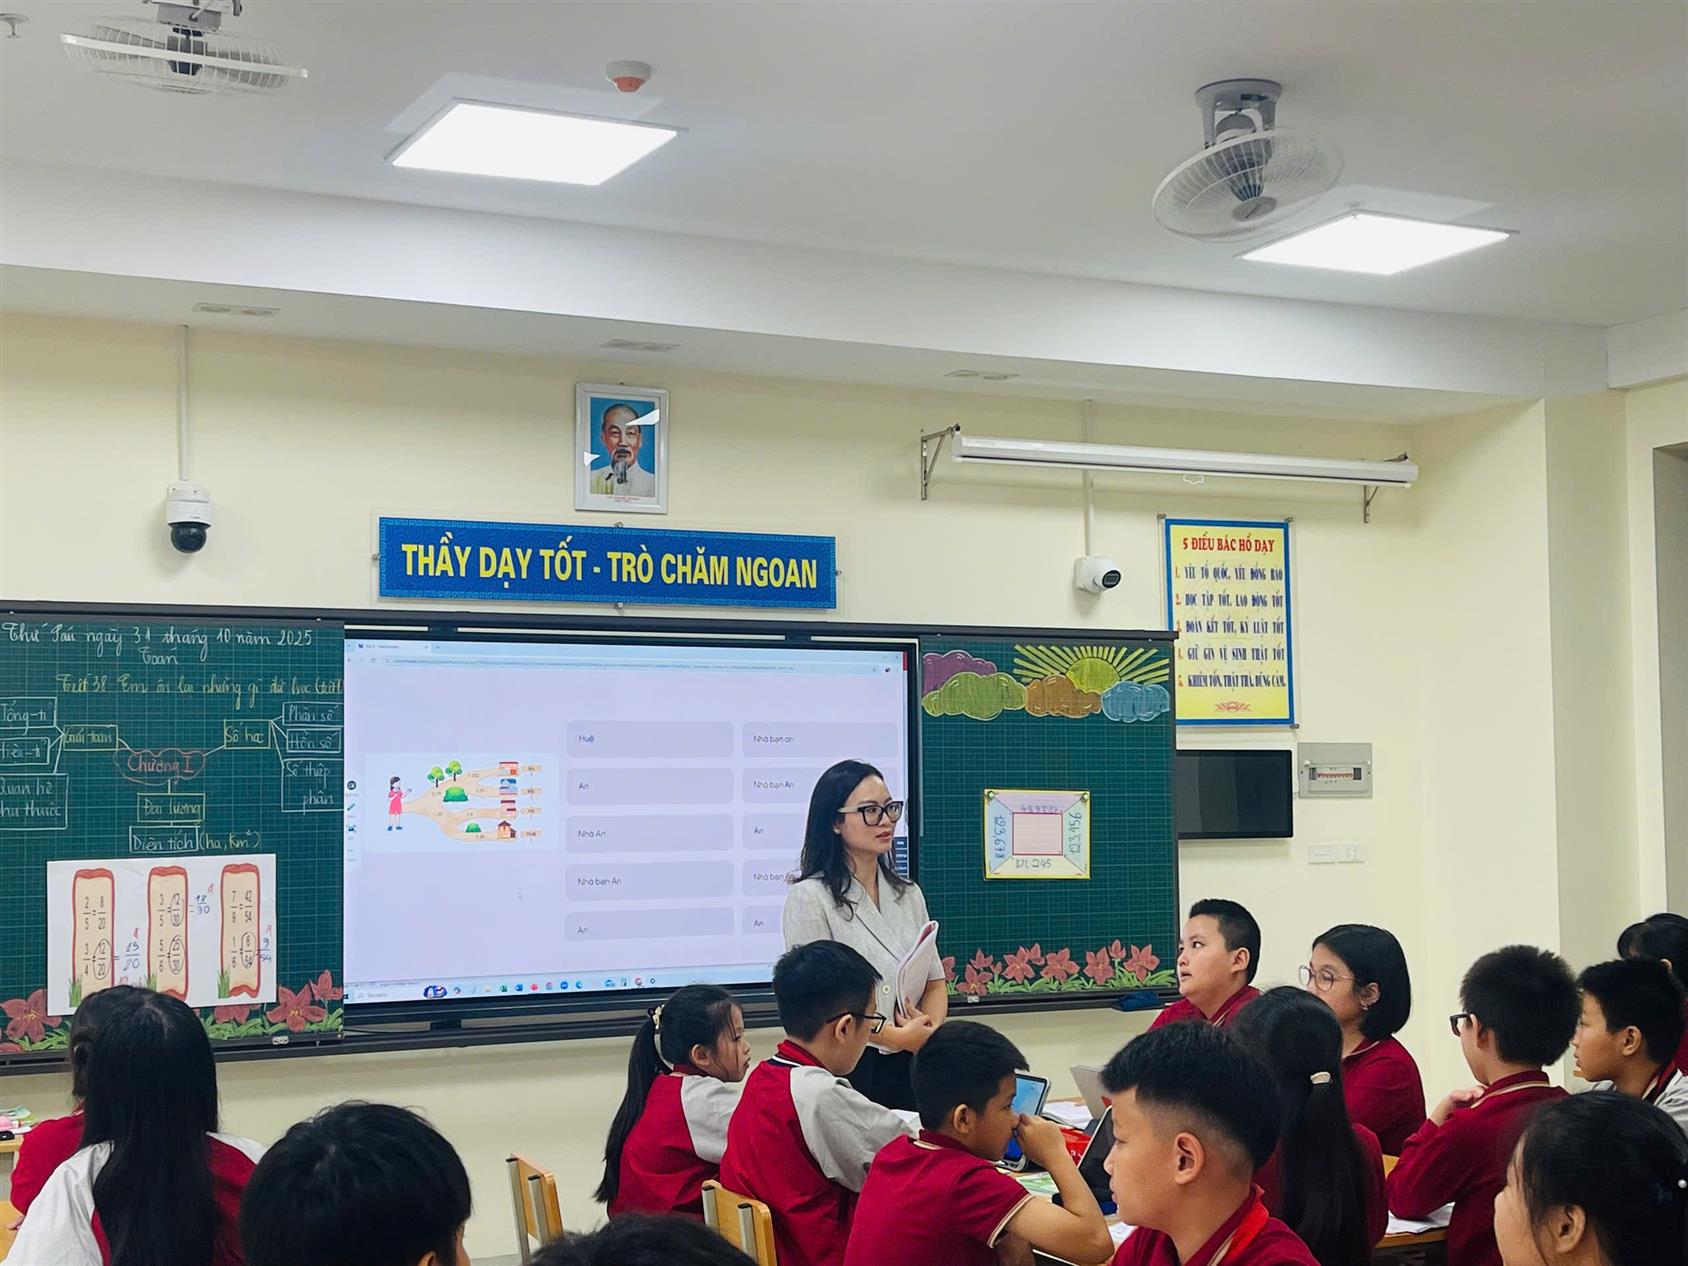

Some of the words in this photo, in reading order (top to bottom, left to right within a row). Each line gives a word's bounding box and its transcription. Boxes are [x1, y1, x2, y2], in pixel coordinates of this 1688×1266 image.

[1183, 538, 1188, 549] 5
[1217, 534, 1236, 551] BÁC
[1255, 540, 1275, 555] DẠY
[402, 531, 471, 577] THẦY
[479, 547, 532, 588] DẠY
[539, 535, 586, 580] TỐT
[607, 544, 654, 583] TRÒ
[660, 546, 729, 585] CHĂM
[736, 556, 817, 588] NGOAN
[86, 628, 122, 657] ngày
[133, 626, 151, 644] 31
[162, 626, 208, 662] tháng
[216, 628, 231, 645] 10
[236, 631, 271, 645] năm
[276, 630, 313, 646] 2025
[138, 647, 179, 664] Toán
